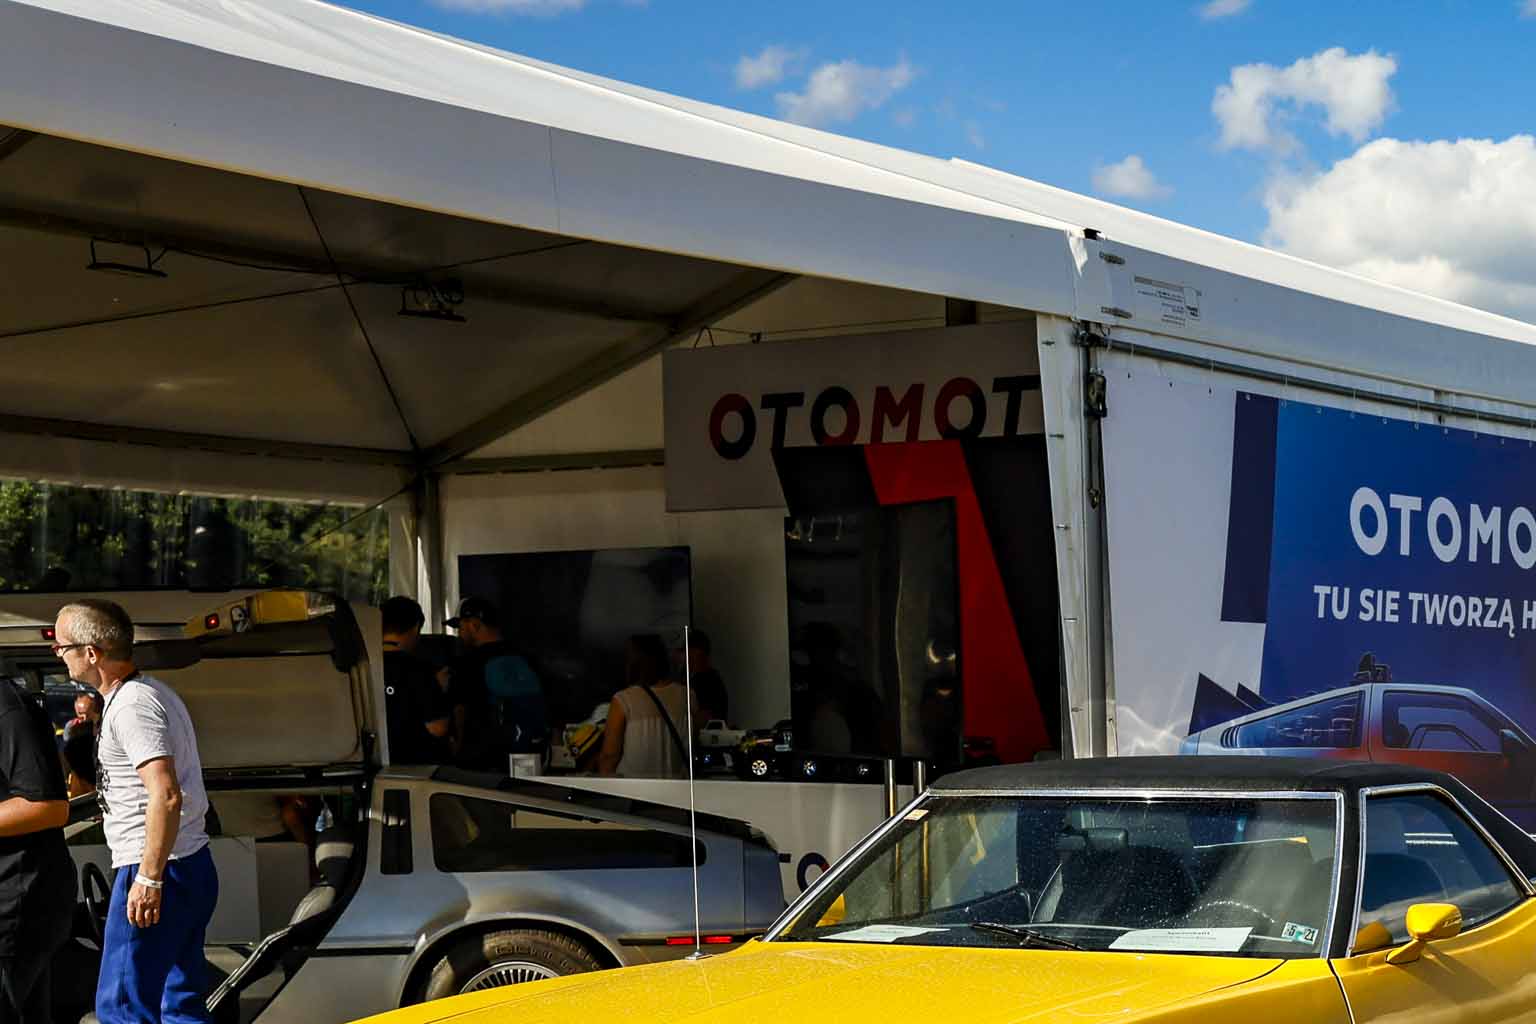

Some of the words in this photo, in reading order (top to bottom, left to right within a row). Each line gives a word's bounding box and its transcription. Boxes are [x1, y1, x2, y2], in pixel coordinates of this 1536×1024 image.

[1313, 585, 1350, 620] TU
[1359, 588, 1400, 623] SIE
[1408, 592, 1515, 638] TWORZĄ
